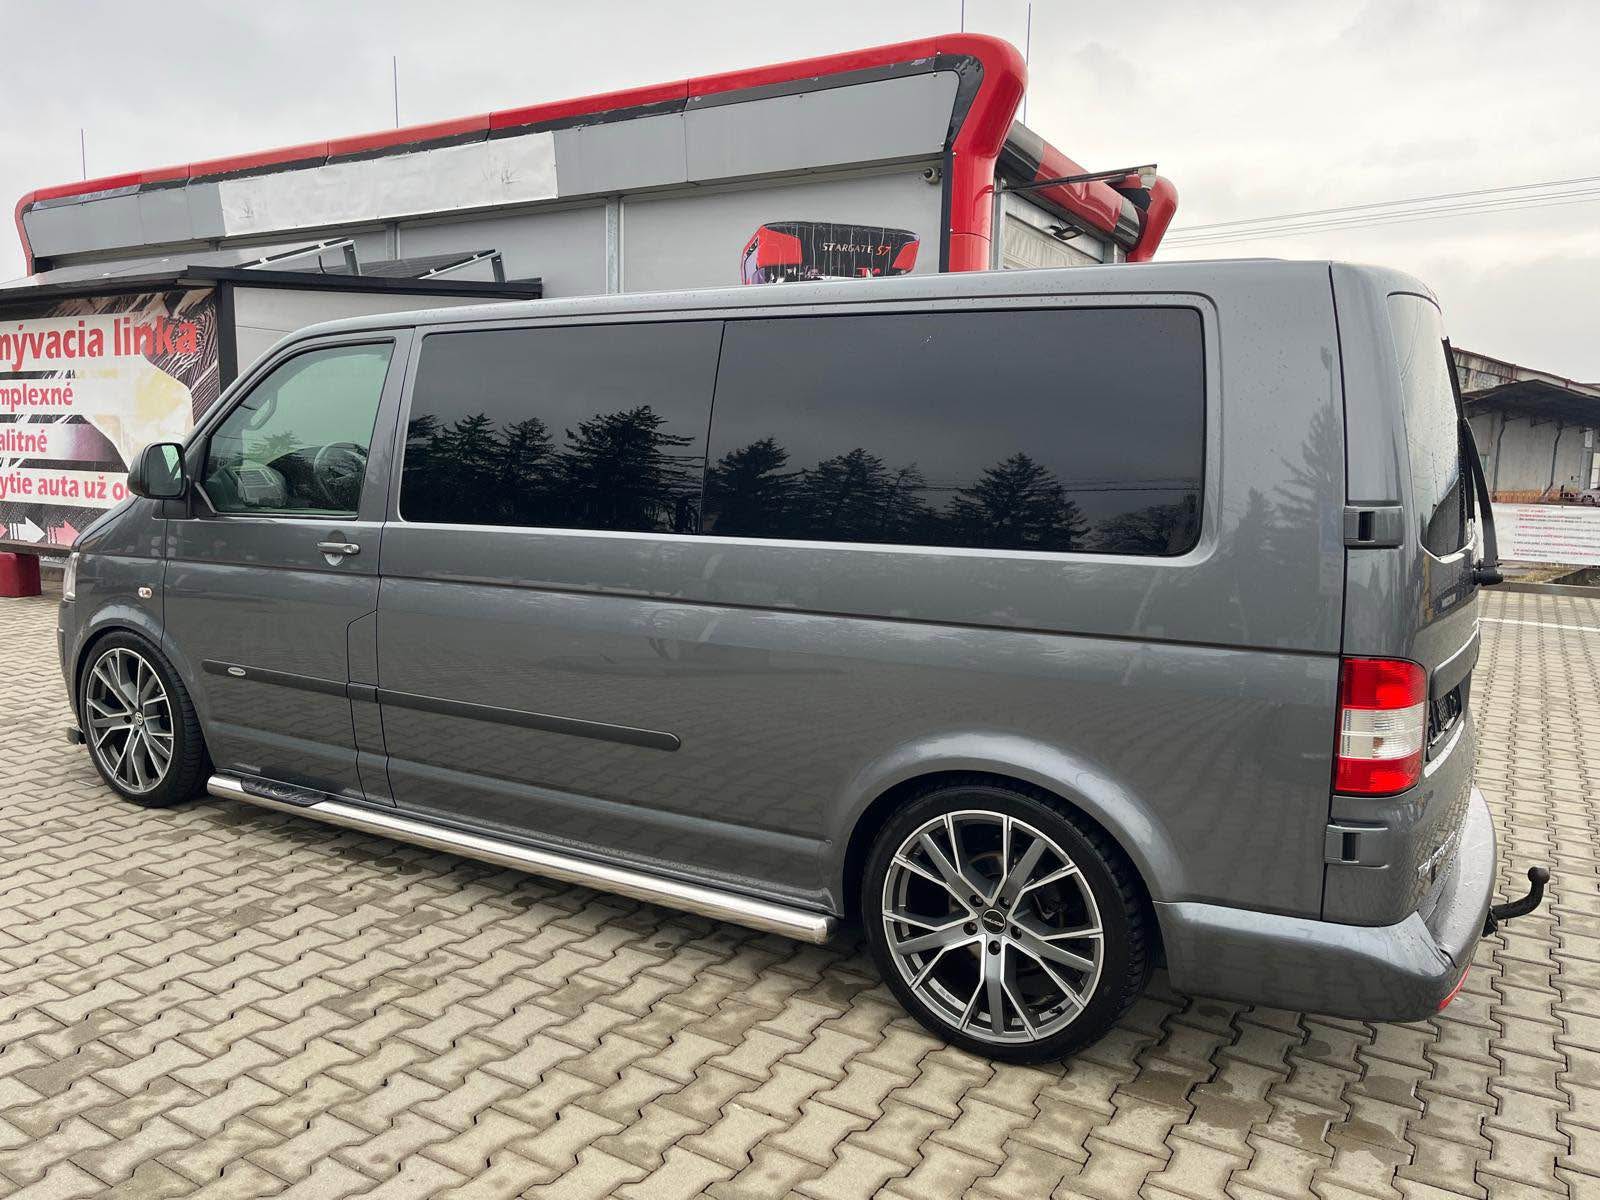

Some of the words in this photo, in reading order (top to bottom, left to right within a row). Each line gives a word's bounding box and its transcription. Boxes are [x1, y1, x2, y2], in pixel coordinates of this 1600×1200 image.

[822, 243, 873, 254] STARGATE
[876, 245, 891, 256] S7
[114, 315, 197, 356] linka
[38, 476, 79, 497] auta
[84, 475, 107, 499] už
